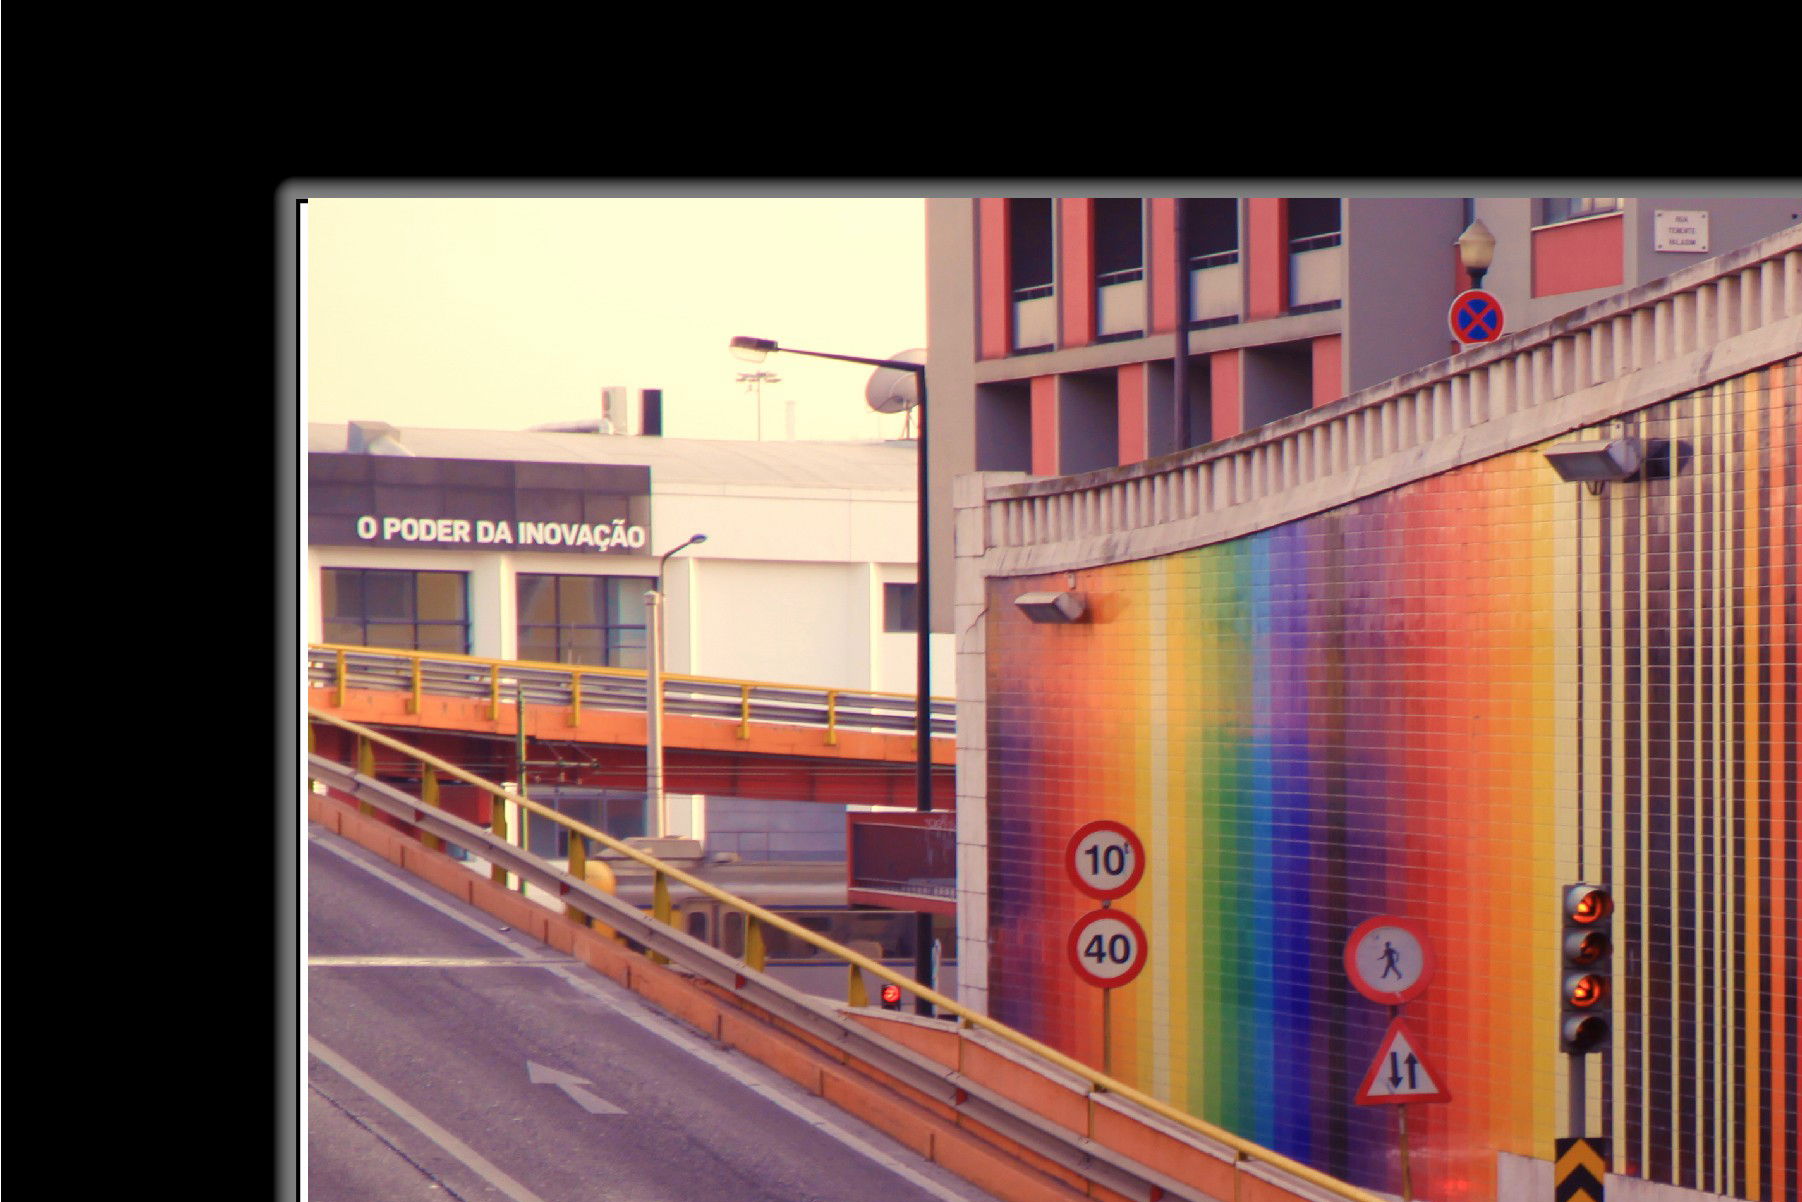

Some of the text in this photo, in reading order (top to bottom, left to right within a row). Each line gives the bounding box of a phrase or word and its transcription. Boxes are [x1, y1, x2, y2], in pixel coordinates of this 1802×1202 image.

[356, 515, 646, 552] O PODER DA INOVAÇÃO
[1084, 934, 1131, 965] 40
